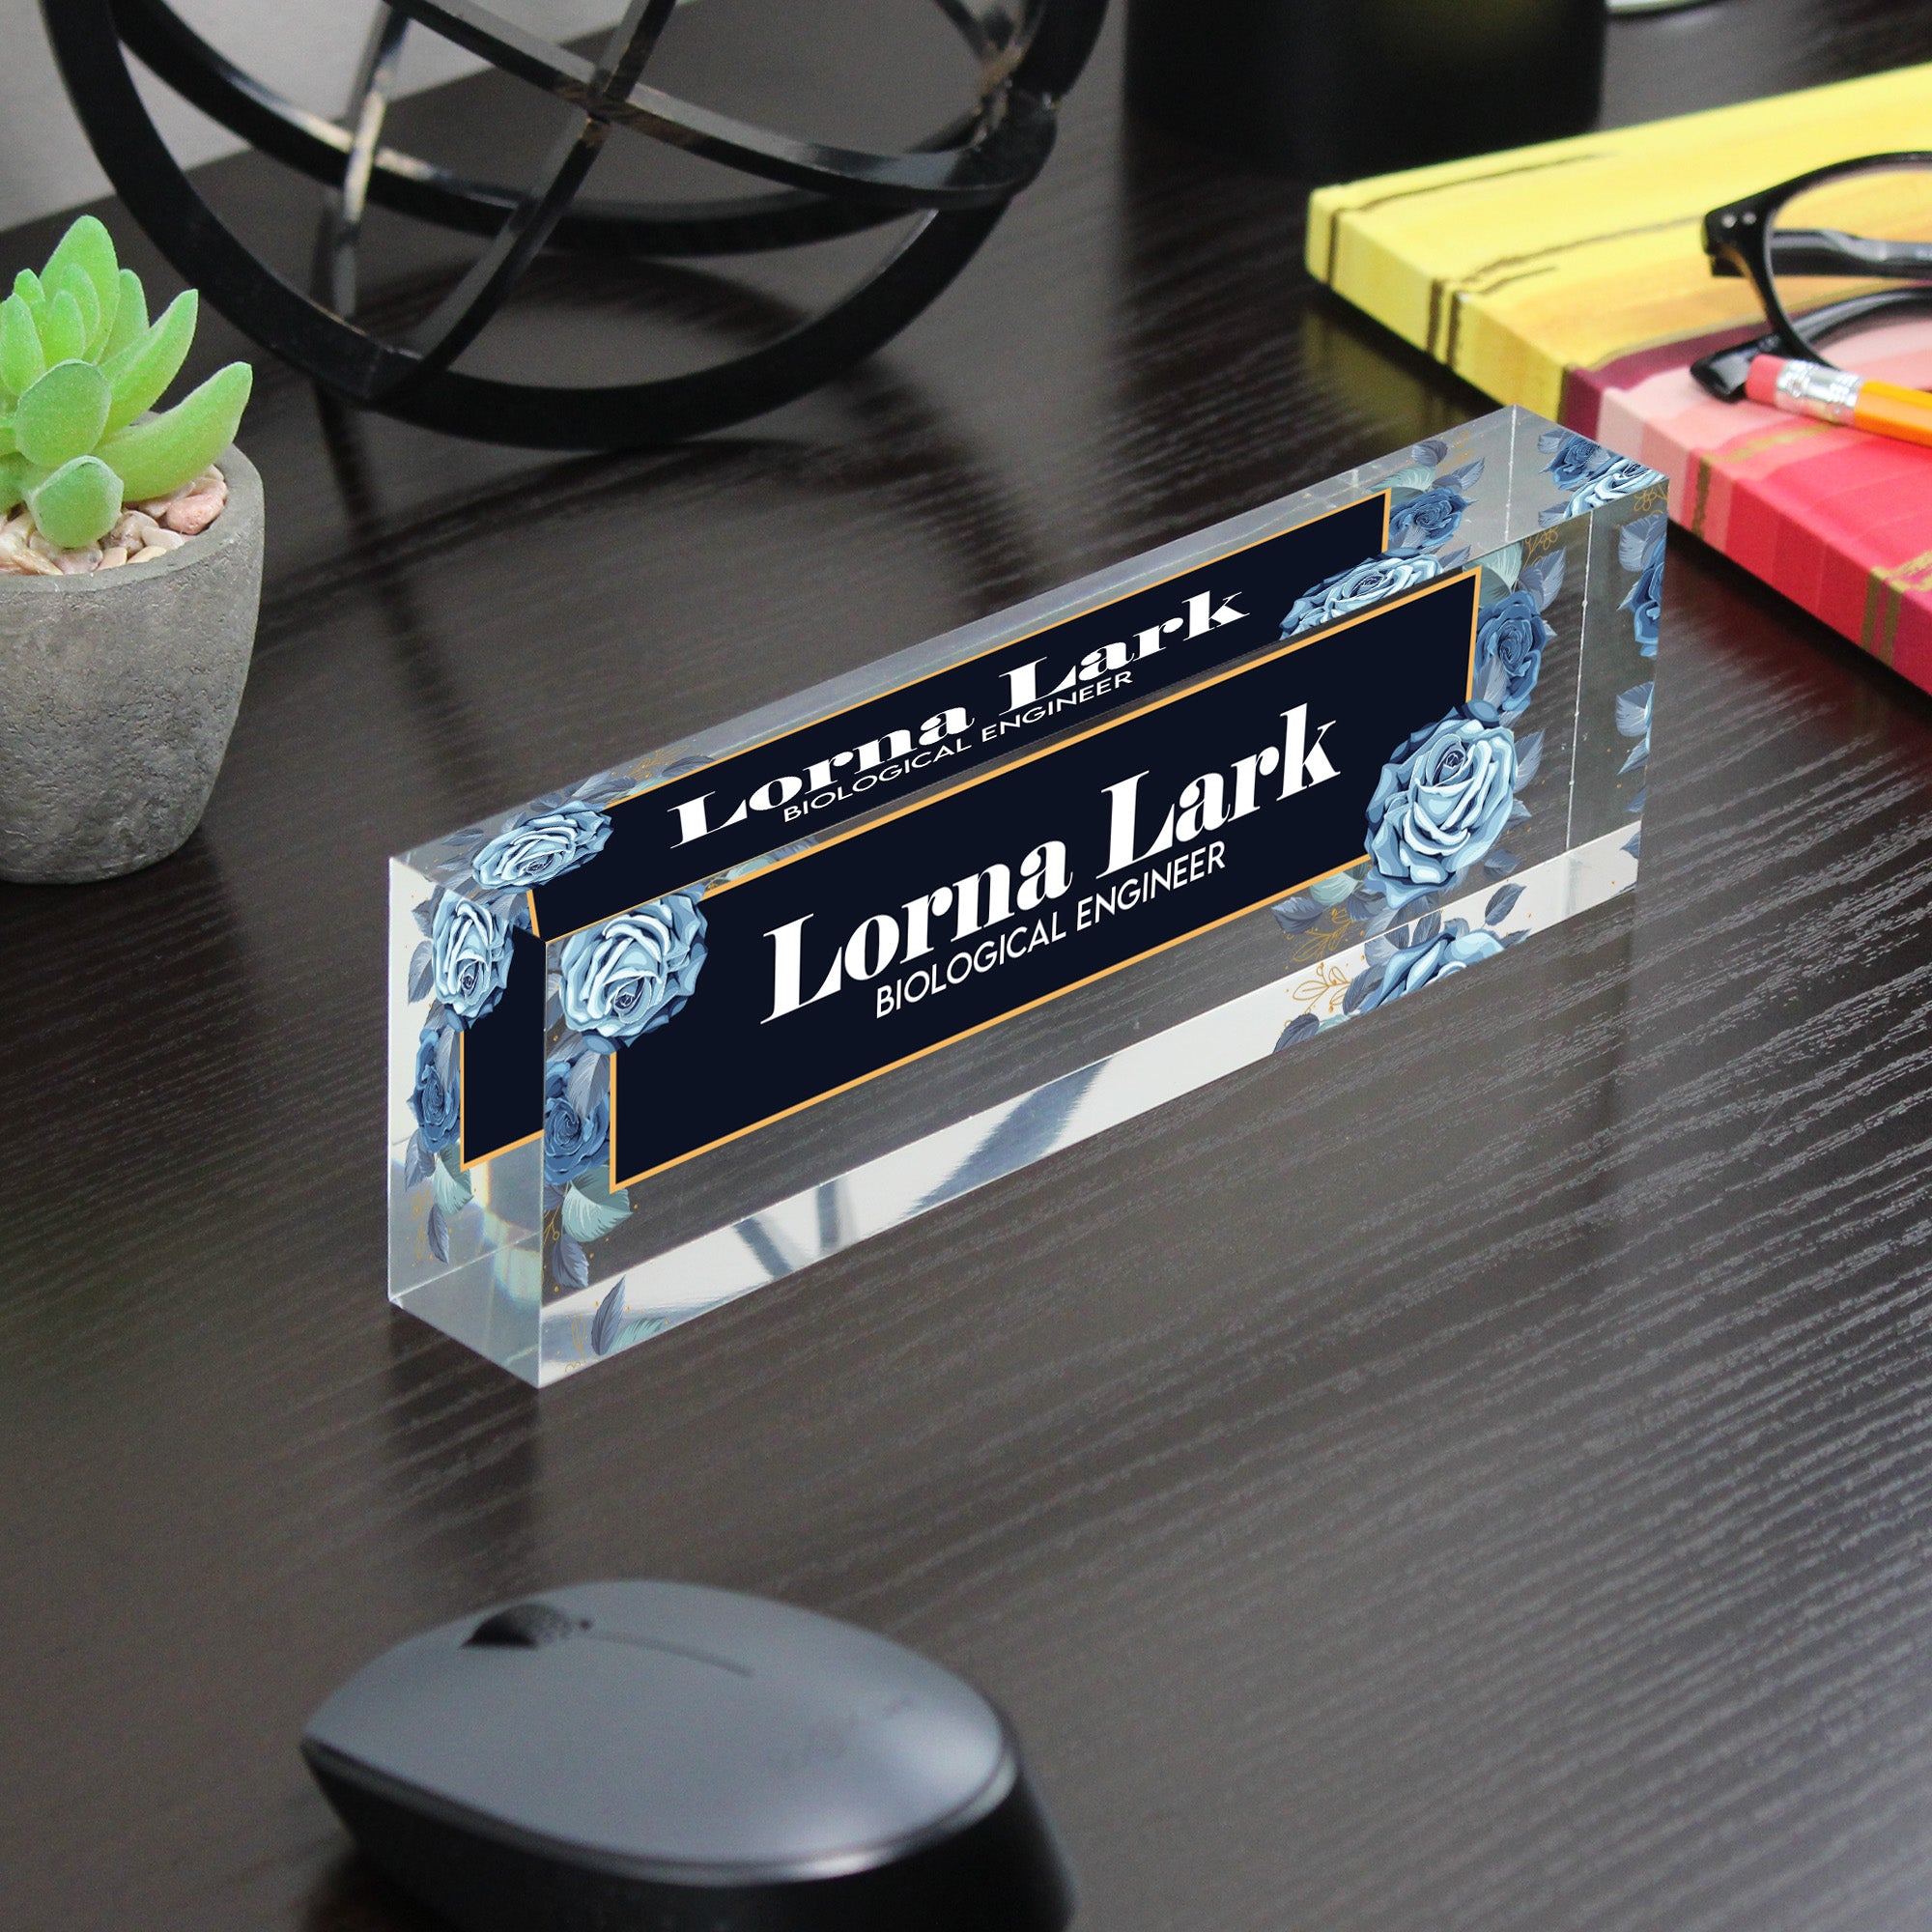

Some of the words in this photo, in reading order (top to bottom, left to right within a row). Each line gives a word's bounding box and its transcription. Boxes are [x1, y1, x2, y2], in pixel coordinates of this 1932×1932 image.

[667, 706, 976, 849] Lorna
[998, 590, 1250, 716] Lark
[783, 738, 973, 823] BIOLOGICAL
[981, 670, 1133, 743] ENGINEER
[760, 840, 1073, 1025] Lorna
[1095, 702, 1342, 880] Lark
[876, 911, 1066, 1019] BIOLOGICAL
[1076, 840, 1226, 932] ENGINEER
